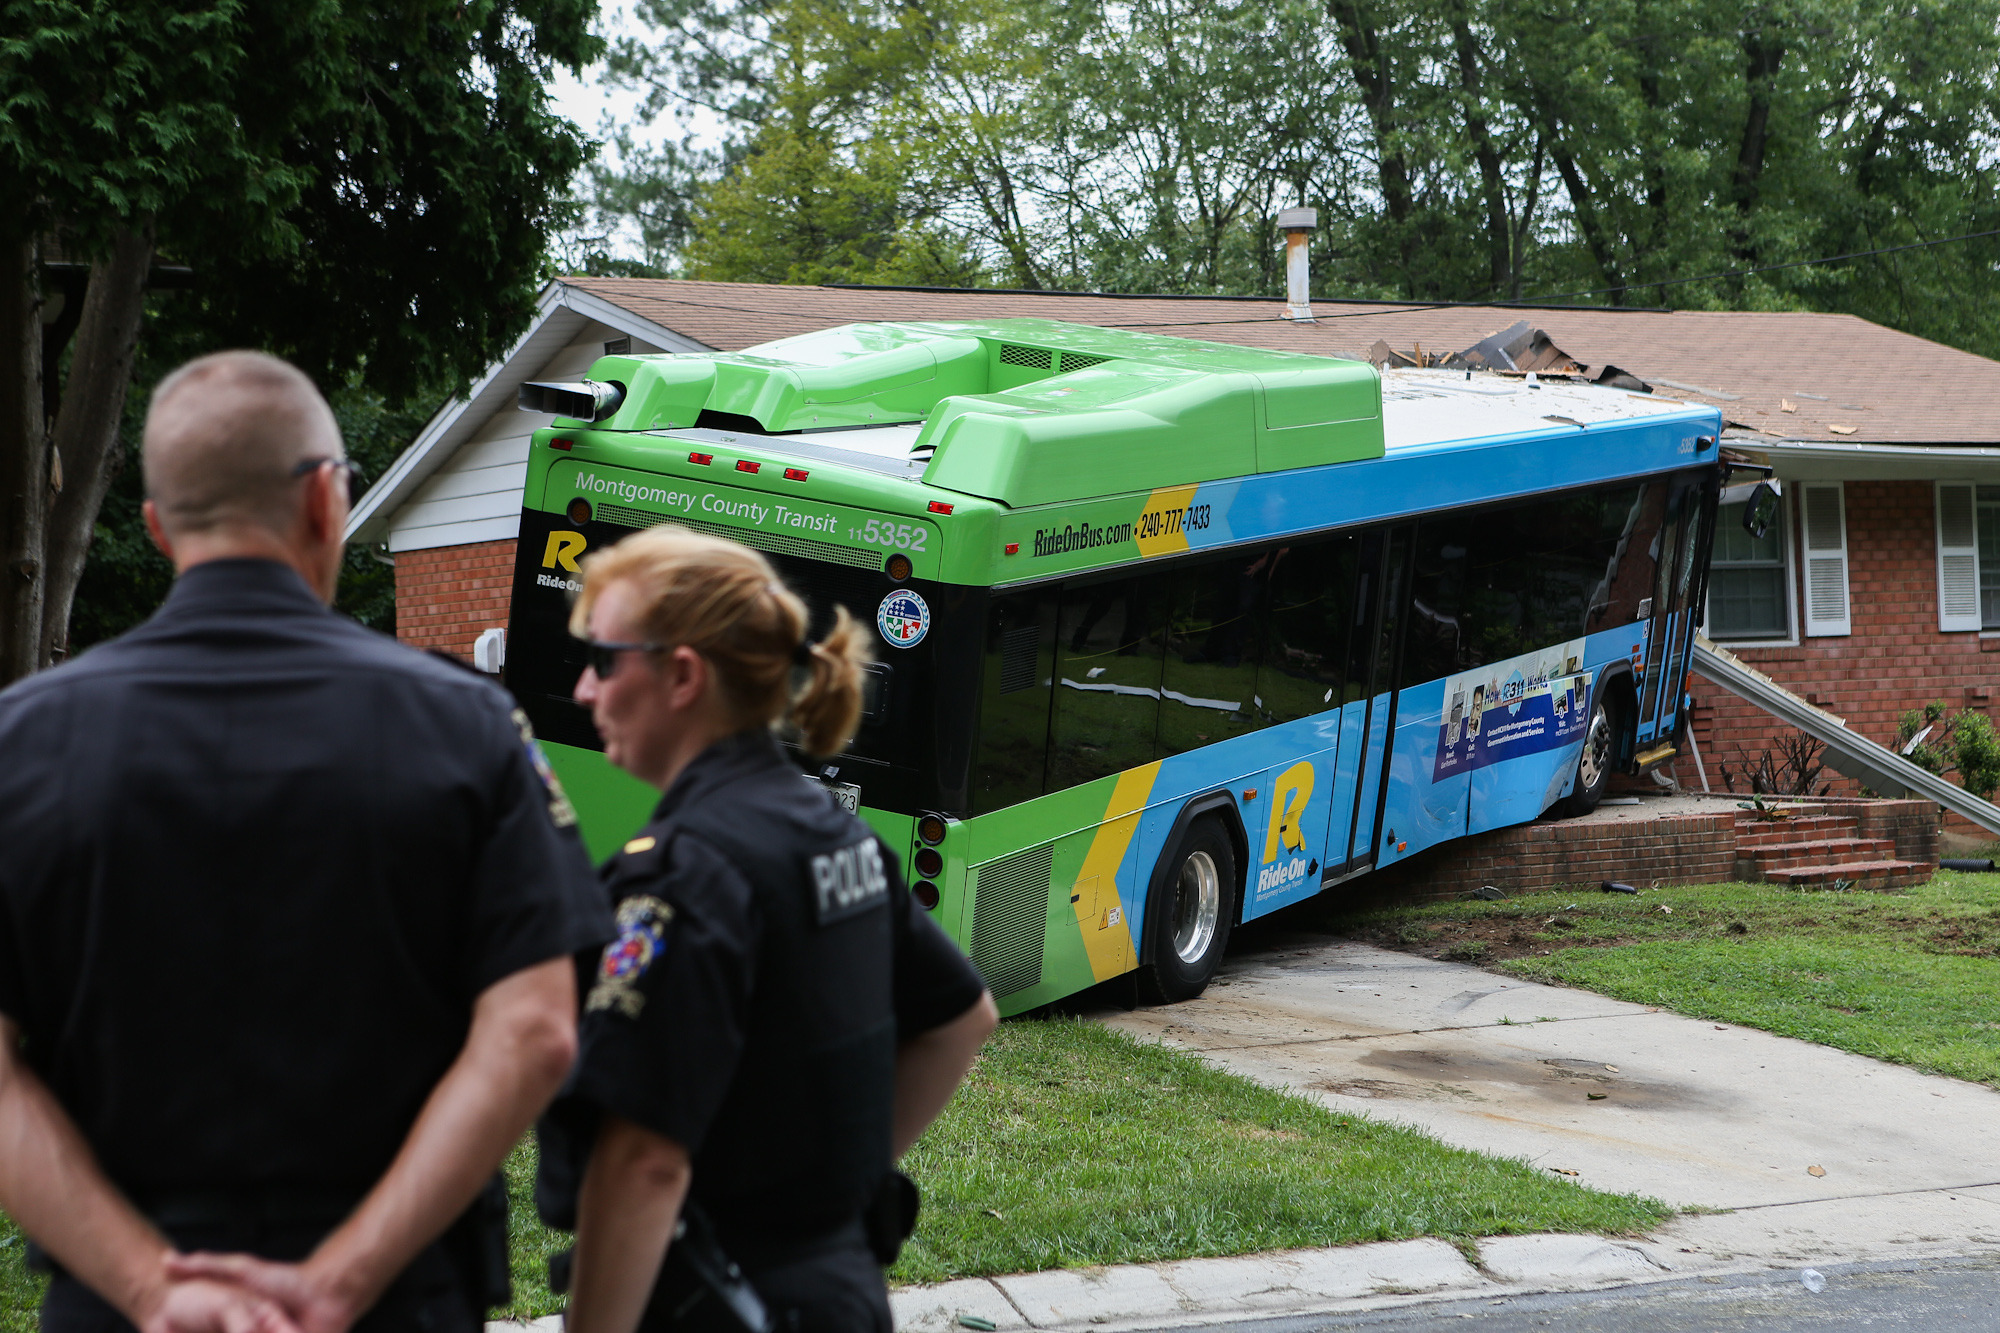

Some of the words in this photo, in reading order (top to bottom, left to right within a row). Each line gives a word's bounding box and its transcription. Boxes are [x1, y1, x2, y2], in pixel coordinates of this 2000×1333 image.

[575, 472, 697, 513] Montgomery
[701, 494, 768, 525] County
[775, 505, 838, 534] Transit
[863, 519, 928, 552] 5352
[1034, 522, 1132, 557] RideOnBus.com
[1140, 504, 1212, 539] 240-777-7433
